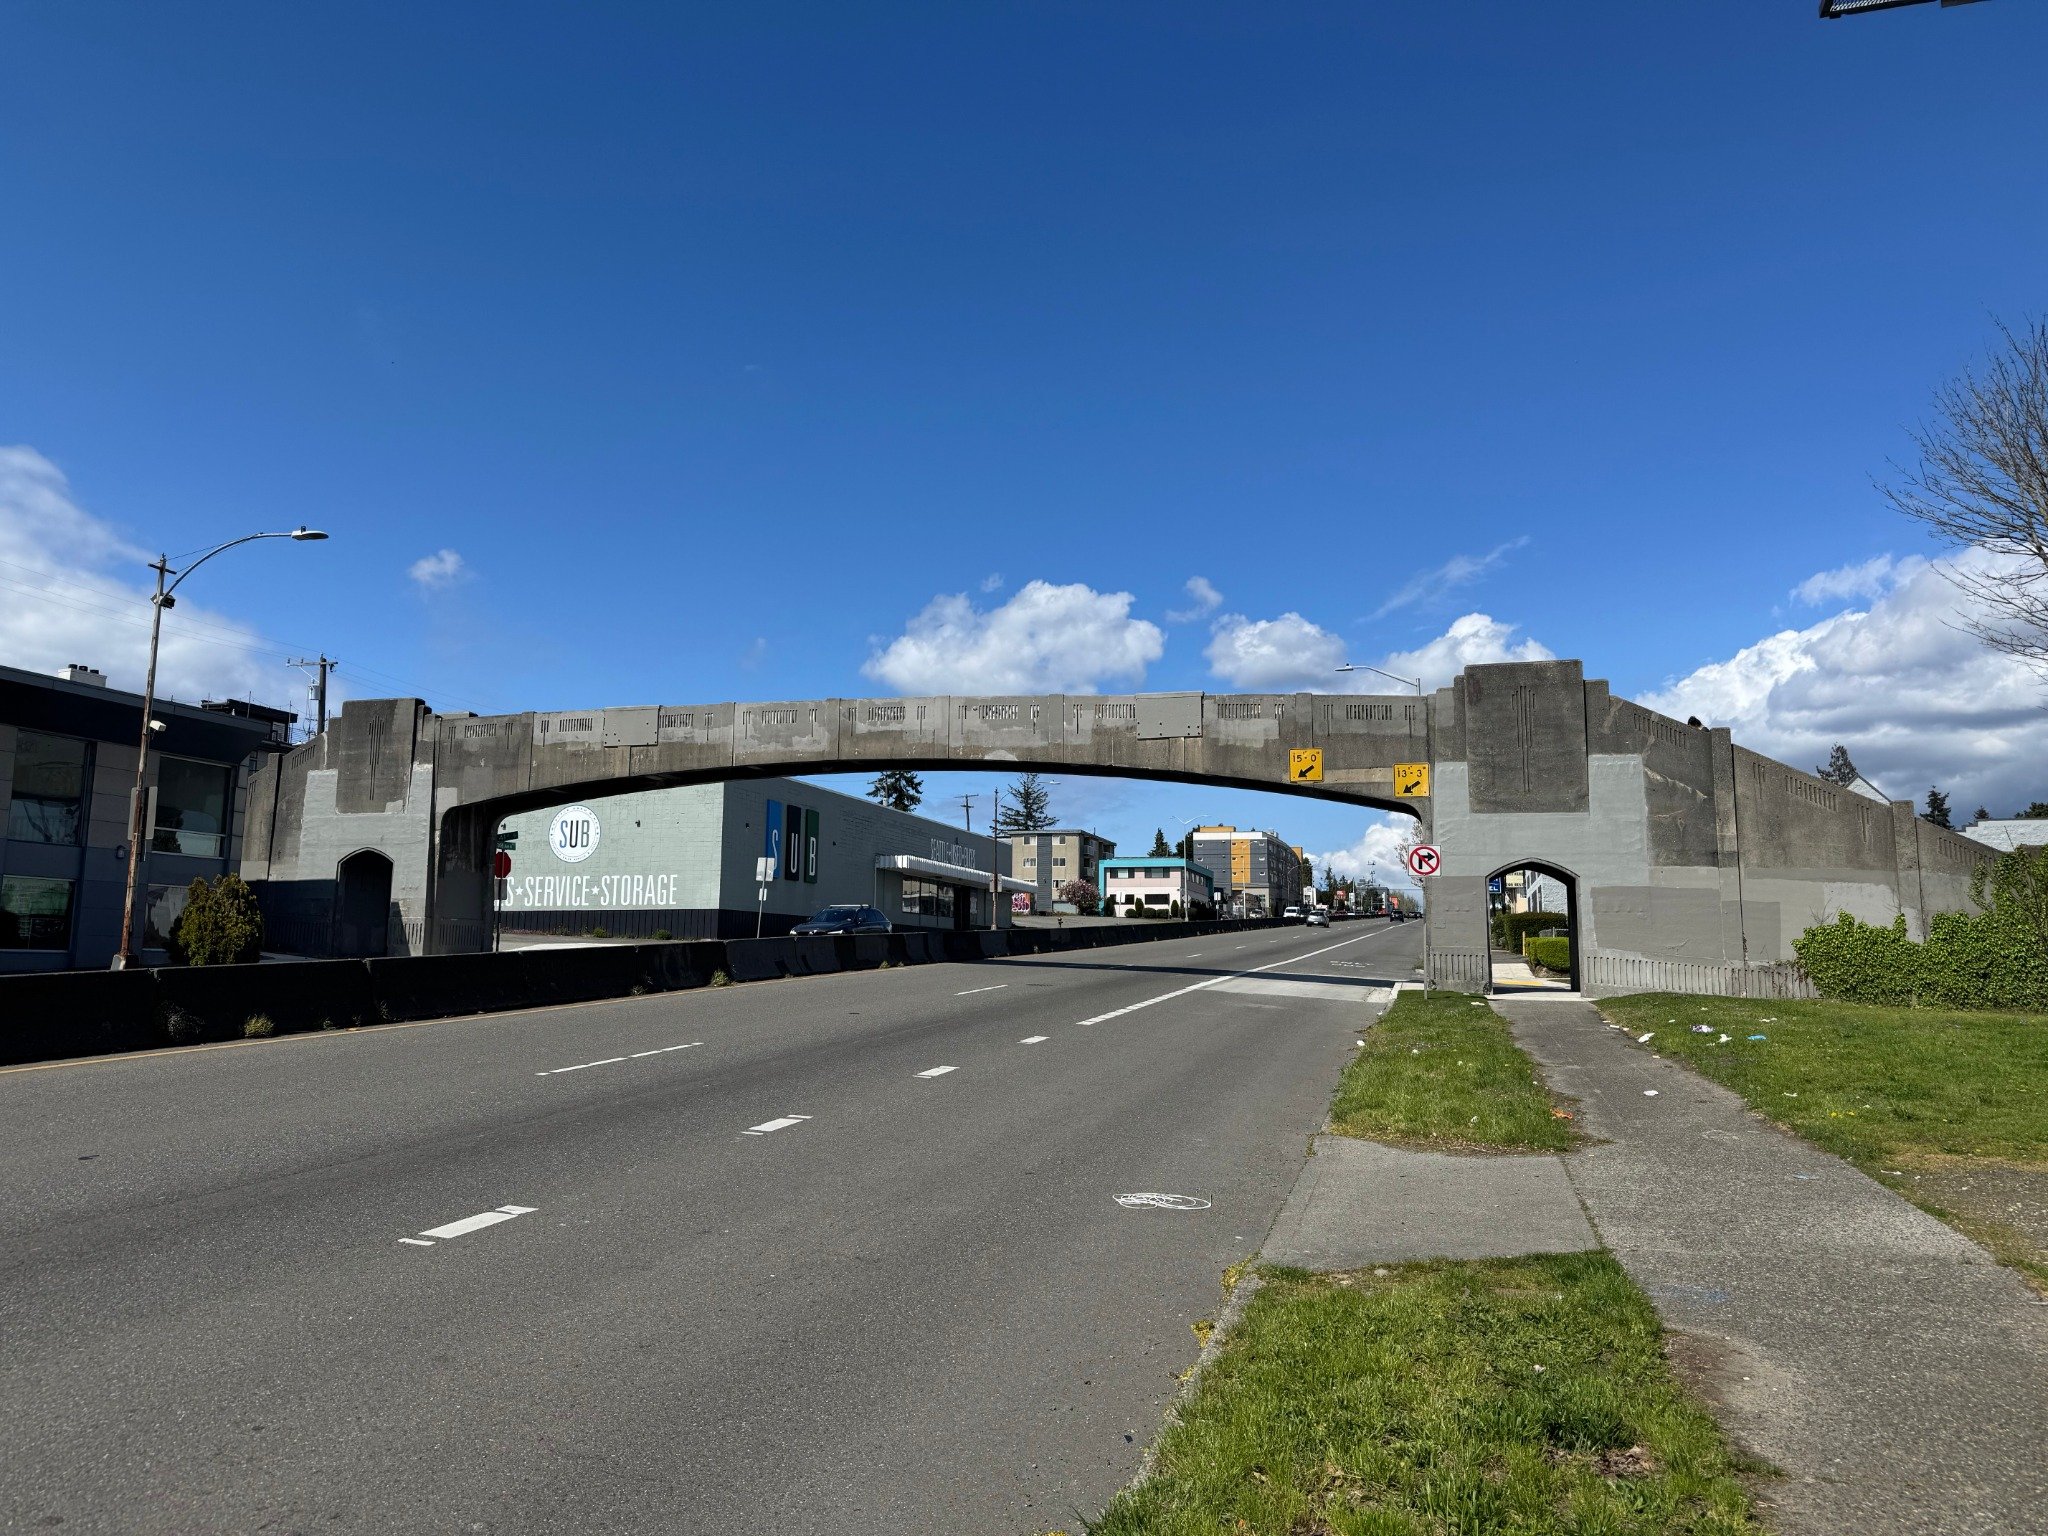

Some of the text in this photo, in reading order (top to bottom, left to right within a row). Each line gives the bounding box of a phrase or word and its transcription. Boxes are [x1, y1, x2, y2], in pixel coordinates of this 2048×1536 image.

[559, 819, 590, 848] SUB
[772, 829, 817, 876] SUB
[523, 875, 590, 907] SERVICE
[600, 874, 678, 906] STORAGE
